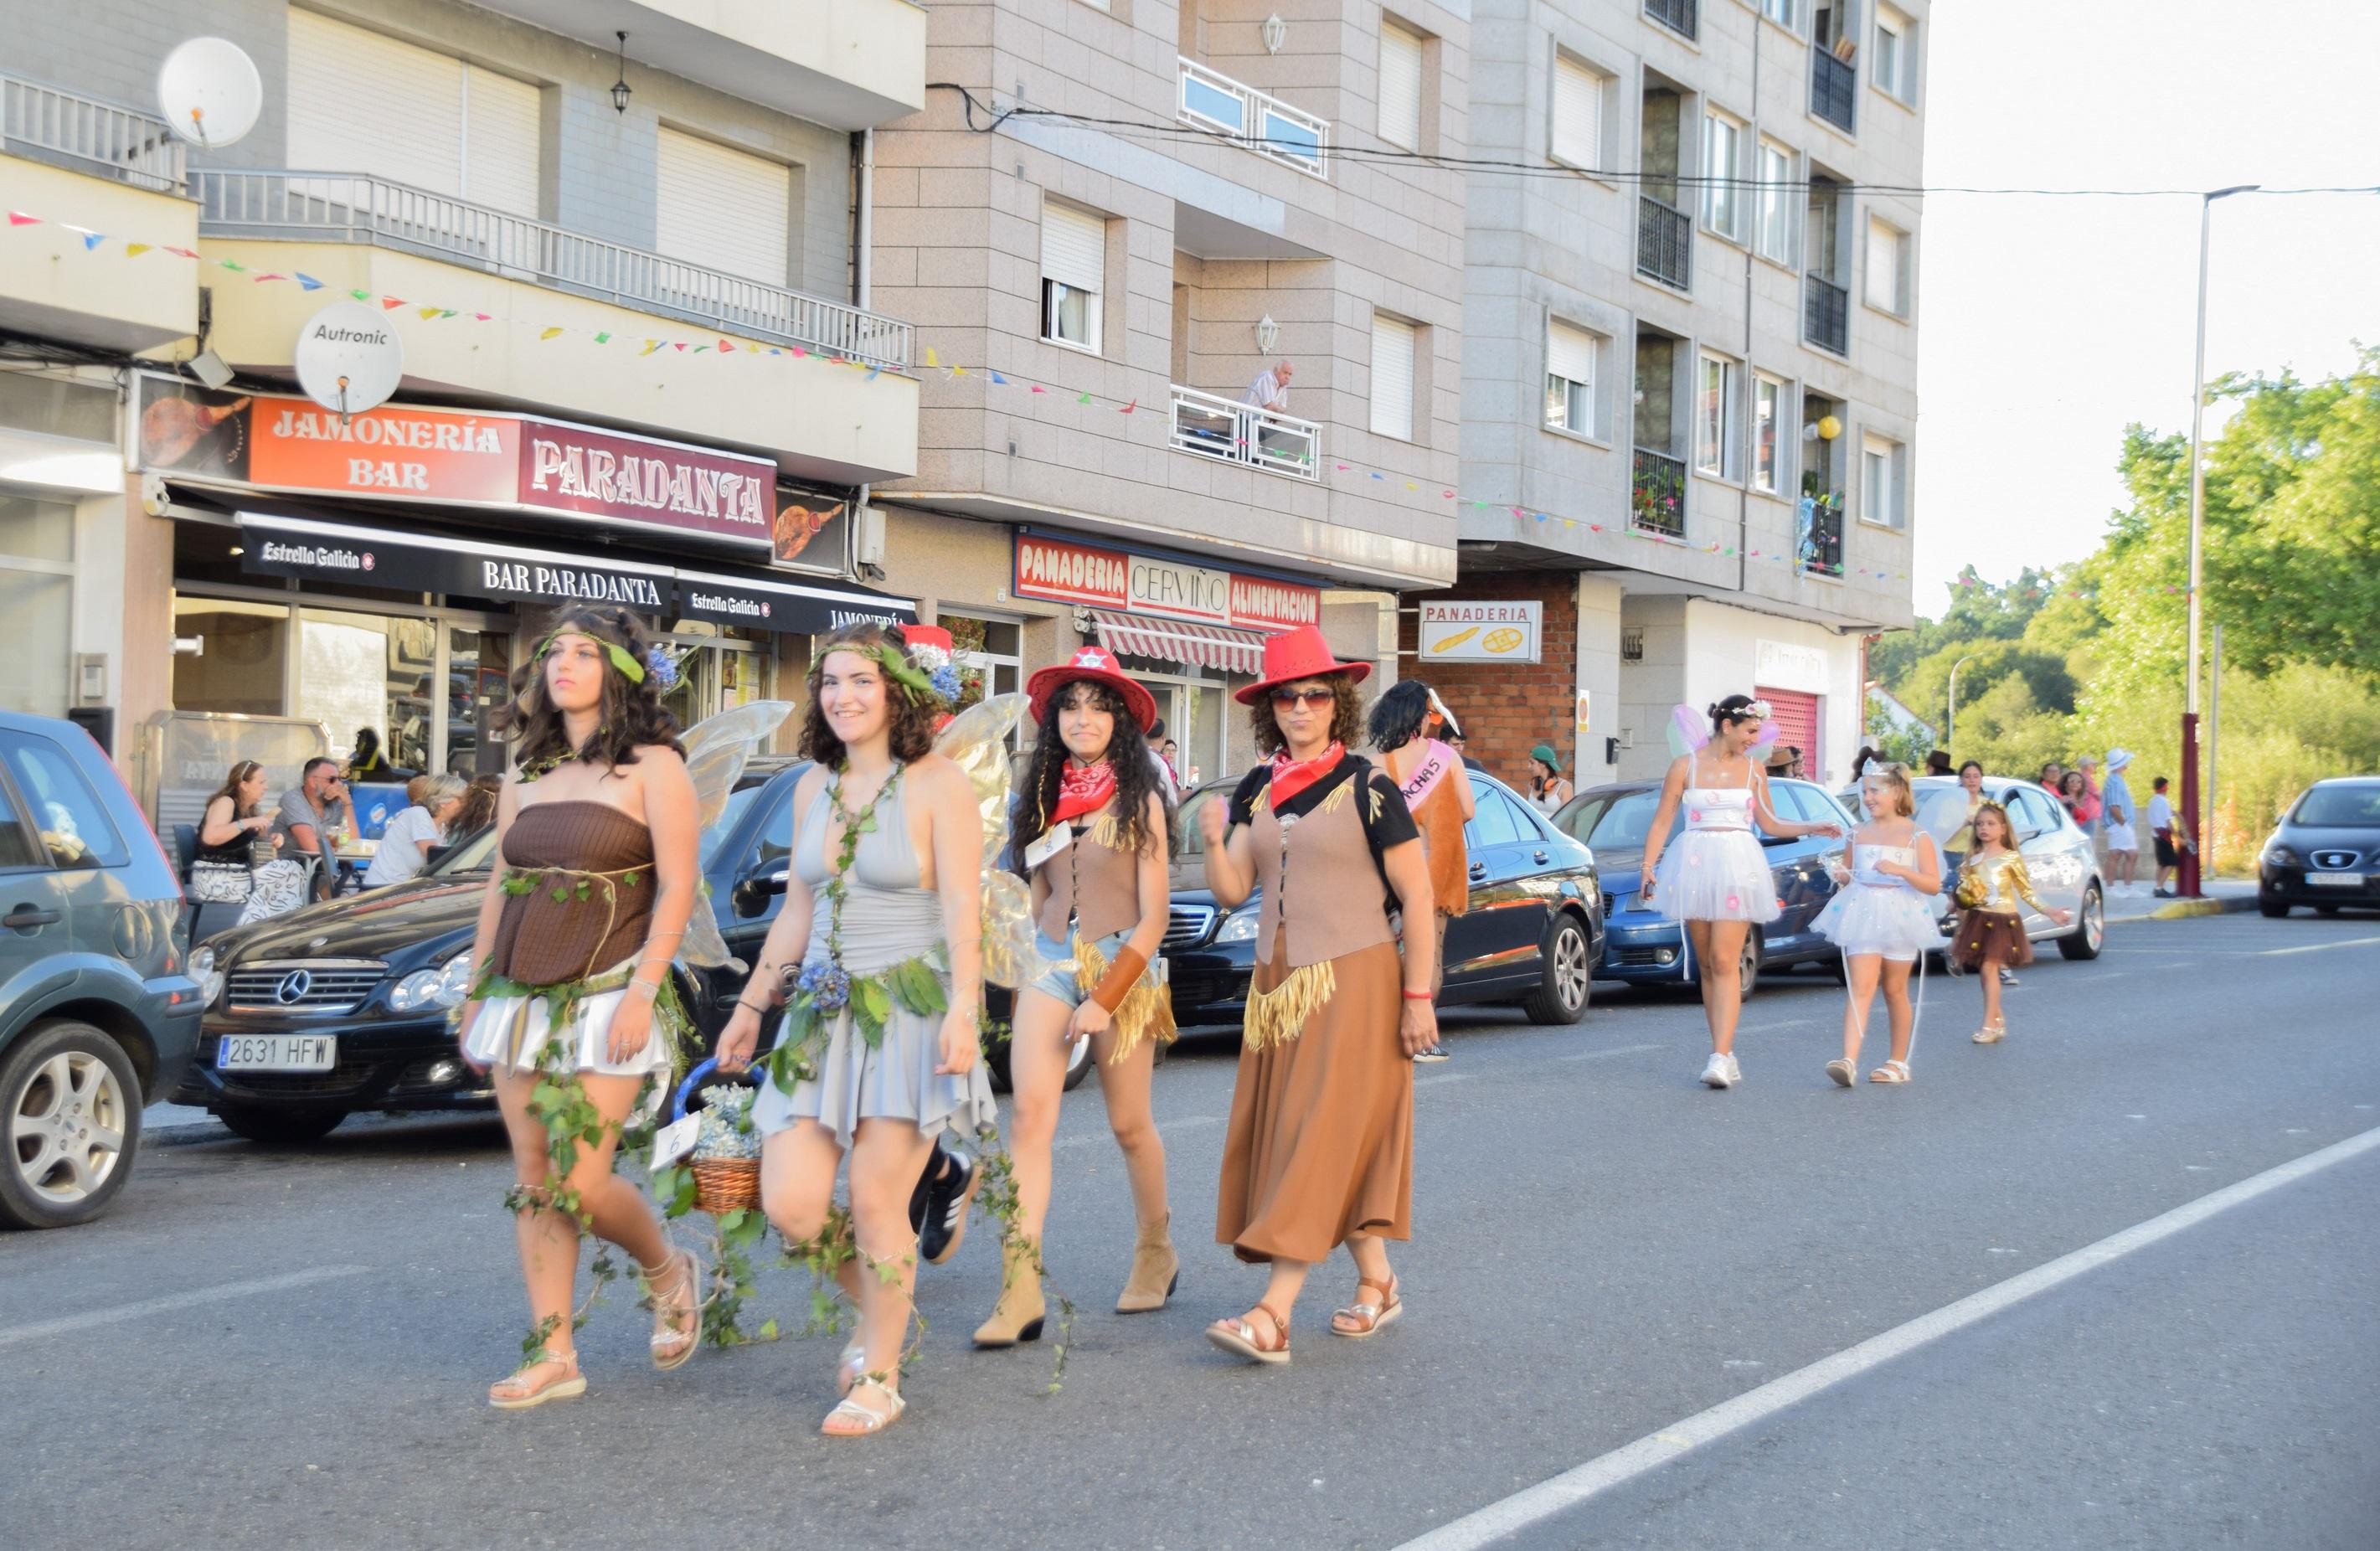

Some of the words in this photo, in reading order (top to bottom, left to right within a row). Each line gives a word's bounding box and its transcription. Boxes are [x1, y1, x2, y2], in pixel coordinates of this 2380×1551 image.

[314, 325, 388, 344] Autronic
[272, 410, 502, 455] JAMONERÍA
[348, 458, 429, 491] BAR
[531, 438, 765, 526] PARADANTA
[262, 541, 316, 565] Estrella
[316, 547, 360, 569] Galicia
[483, 560, 532, 593] BAR
[535, 567, 662, 605] PARADANTA
[1020, 544, 1126, 595] PANADERIA
[1131, 564, 1226, 611] CERVIÑO
[1231, 581, 1316, 624] ALIMENTACION
[691, 592, 727, 612] Estrella
[727, 597, 760, 616] Galicia
[1426, 607, 1527, 621] PANADERIA
[830, 610, 904, 631] JAMONRÍ
[1045, 840, 1053, 853] 8
[1894, 851, 1903, 864] 9
[230, 1039, 276, 1063] 2631
[287, 1039, 327, 1063] HFW
[670, 1133, 682, 1154] 6
